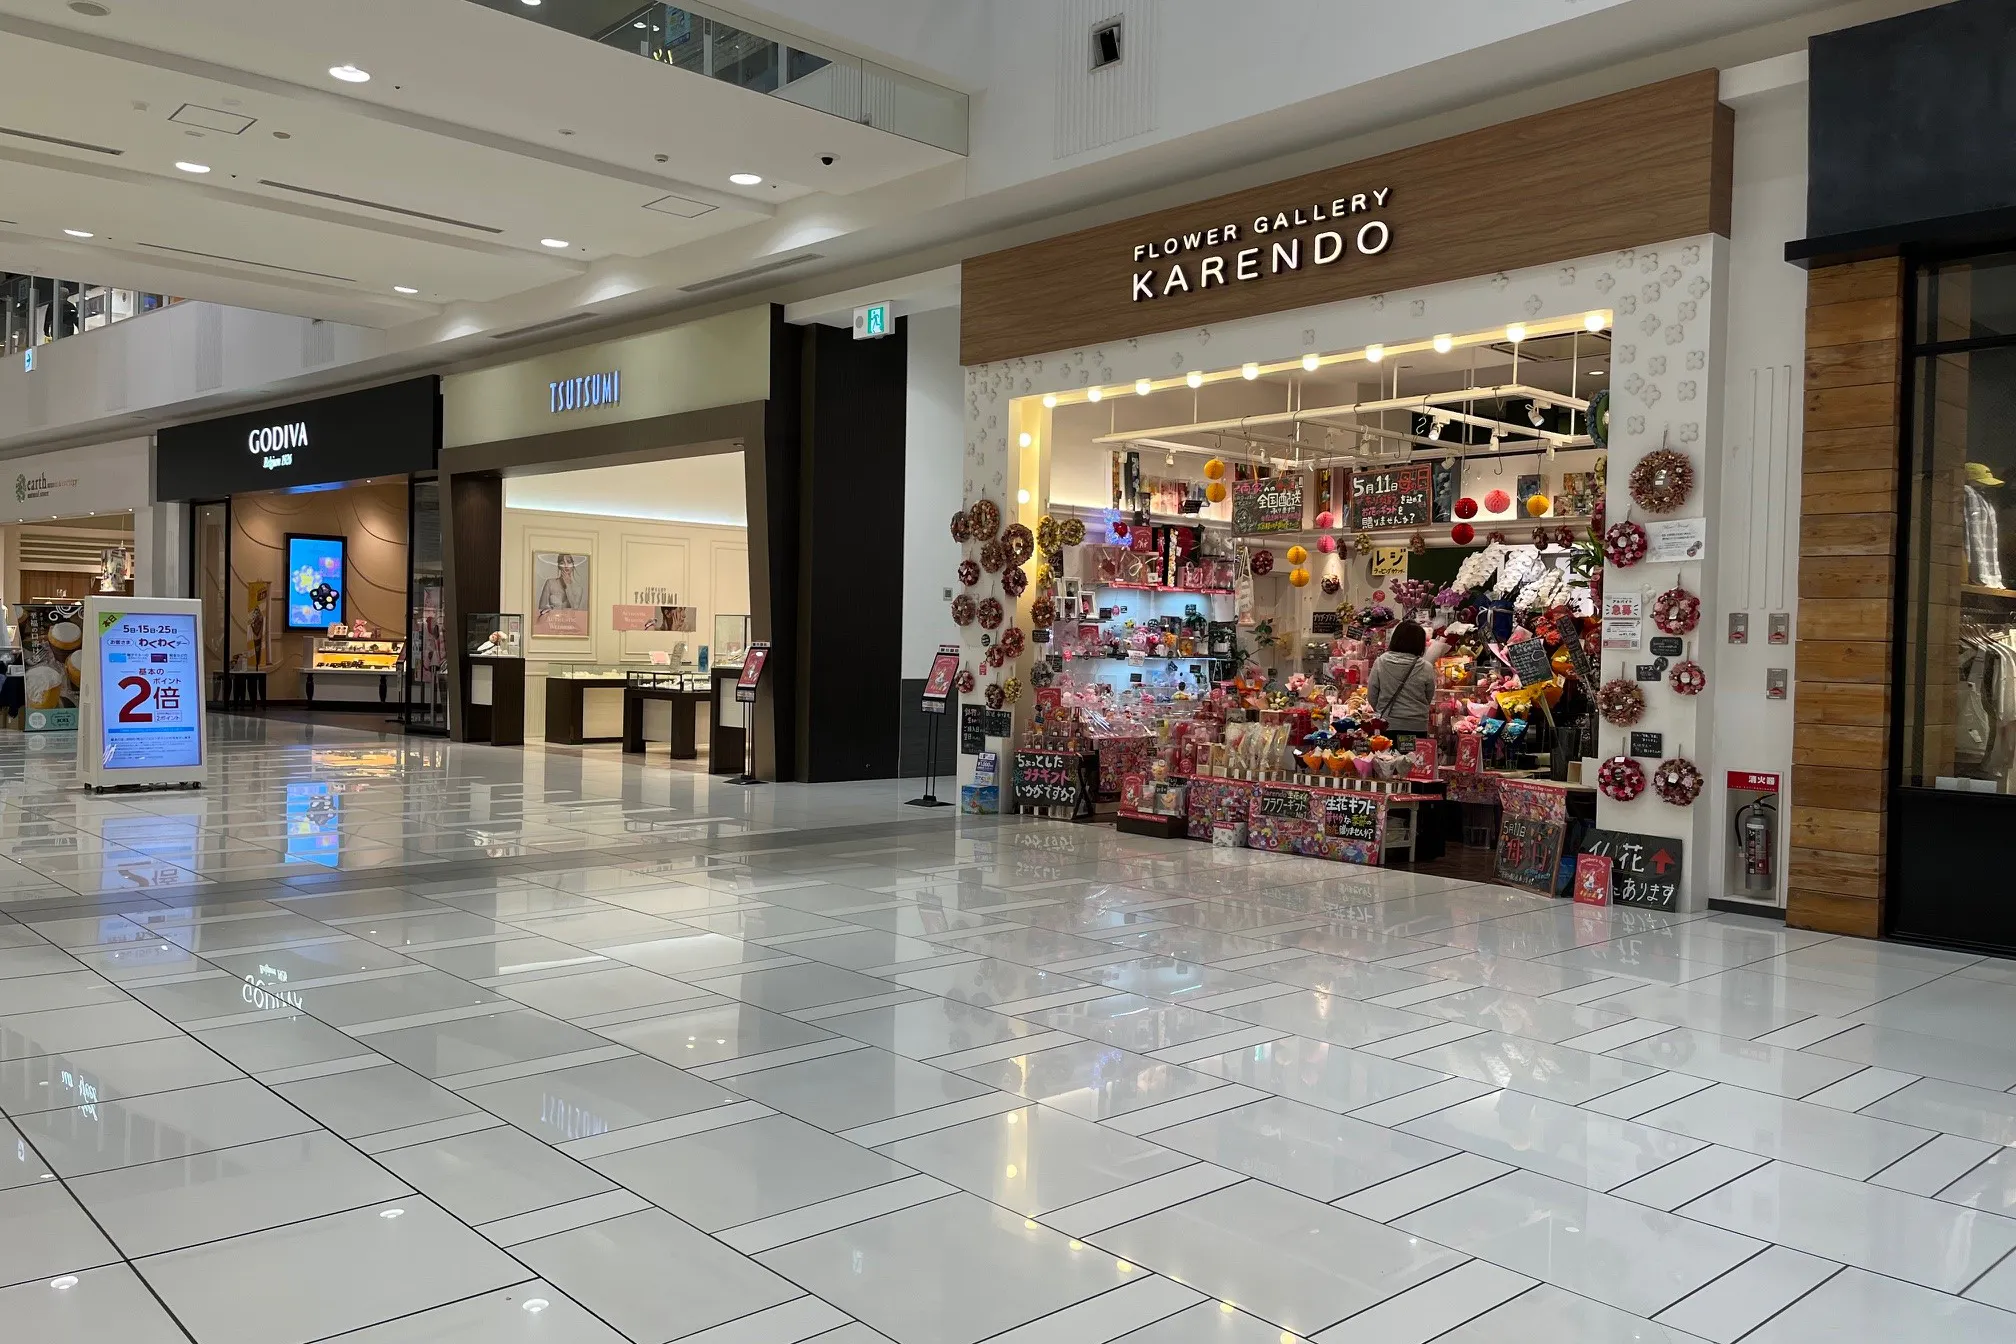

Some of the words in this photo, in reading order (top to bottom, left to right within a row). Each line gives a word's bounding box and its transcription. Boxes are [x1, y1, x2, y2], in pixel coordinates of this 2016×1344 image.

[1133, 224, 1238, 262] FLOWER
[1253, 187, 1390, 235] GALLERY
[1132, 220, 1390, 302] KARENDO
[549, 370, 619, 413] TSUTSUMI
[248, 421, 309, 454] GODIVA
[27, 471, 47, 491] earth
[1257, 490, 1302, 508] 全国配送
[1376, 548, 1406, 567] レジ
[634, 591, 678, 605] TSUTSUMI
[138, 668, 165, 676] 基本の
[117, 675, 153, 723] 2
[153, 686, 181, 710] 倍
[1015, 754, 1063, 768] ちょっとした
[1748, 775, 1775, 785] 消火器
[1015, 784, 1076, 803] いかがですか?
[1263, 797, 1307, 813] フラワーギフト
[1325, 796, 1376, 815] 生花ギフト
